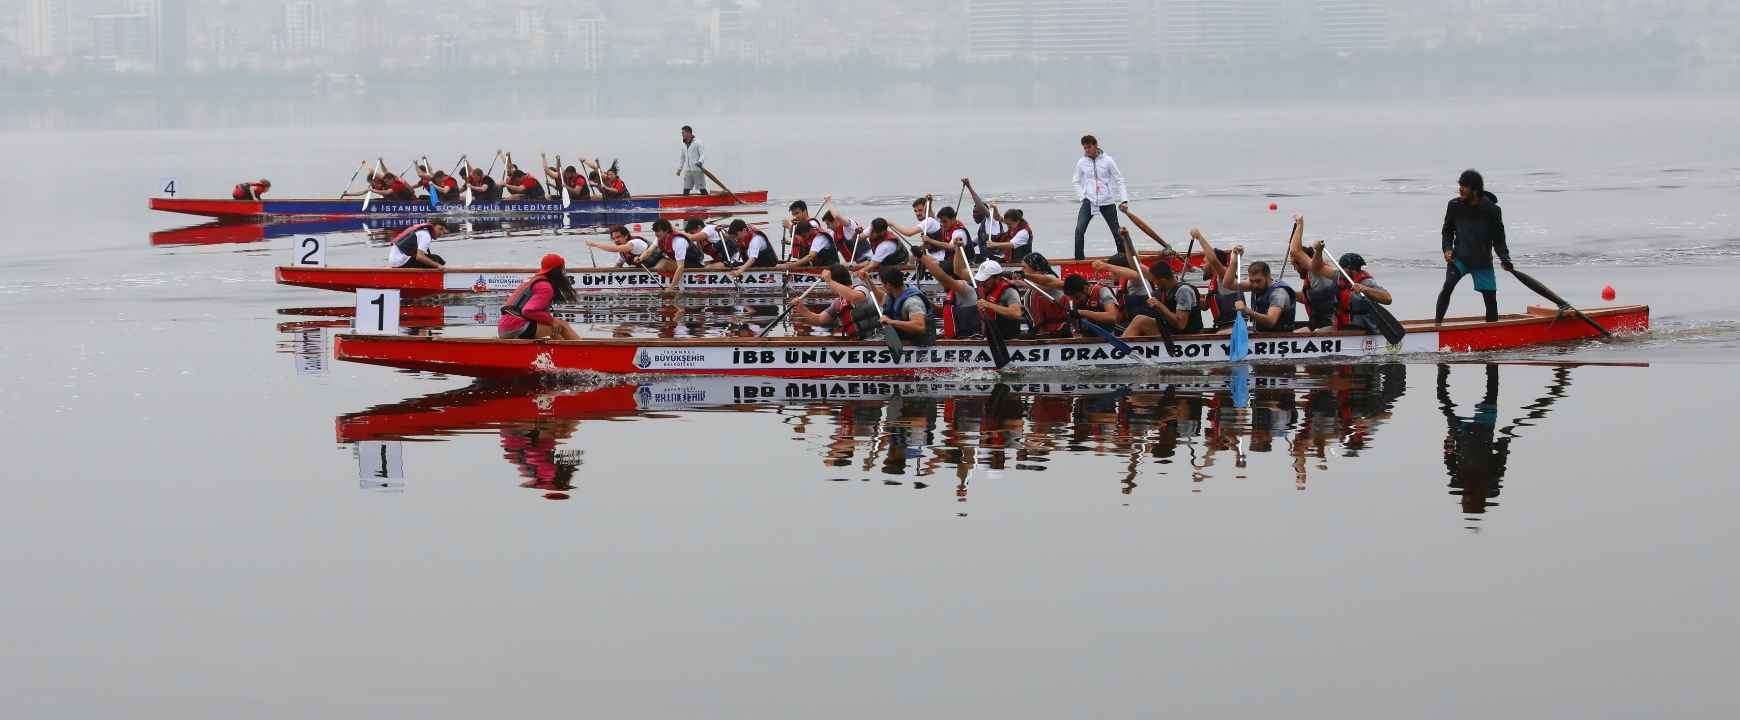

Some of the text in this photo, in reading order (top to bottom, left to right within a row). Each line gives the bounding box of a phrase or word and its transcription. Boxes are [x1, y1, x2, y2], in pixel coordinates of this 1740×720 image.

[164, 180, 176, 197] 4
[382, 202, 562, 212] İSTANBUL BÜYÜŞEHİR BELEDİYESİ
[300, 237, 320, 265] 2
[370, 293, 385, 332] 1
[654, 353, 705, 364] BÜYÜKŞEHİR
[732, 347, 776, 364] İBB
[785, 347, 1050, 364] ÜNİVERSTELERAASI
[1220, 339, 1342, 357] YRIŞLARI
